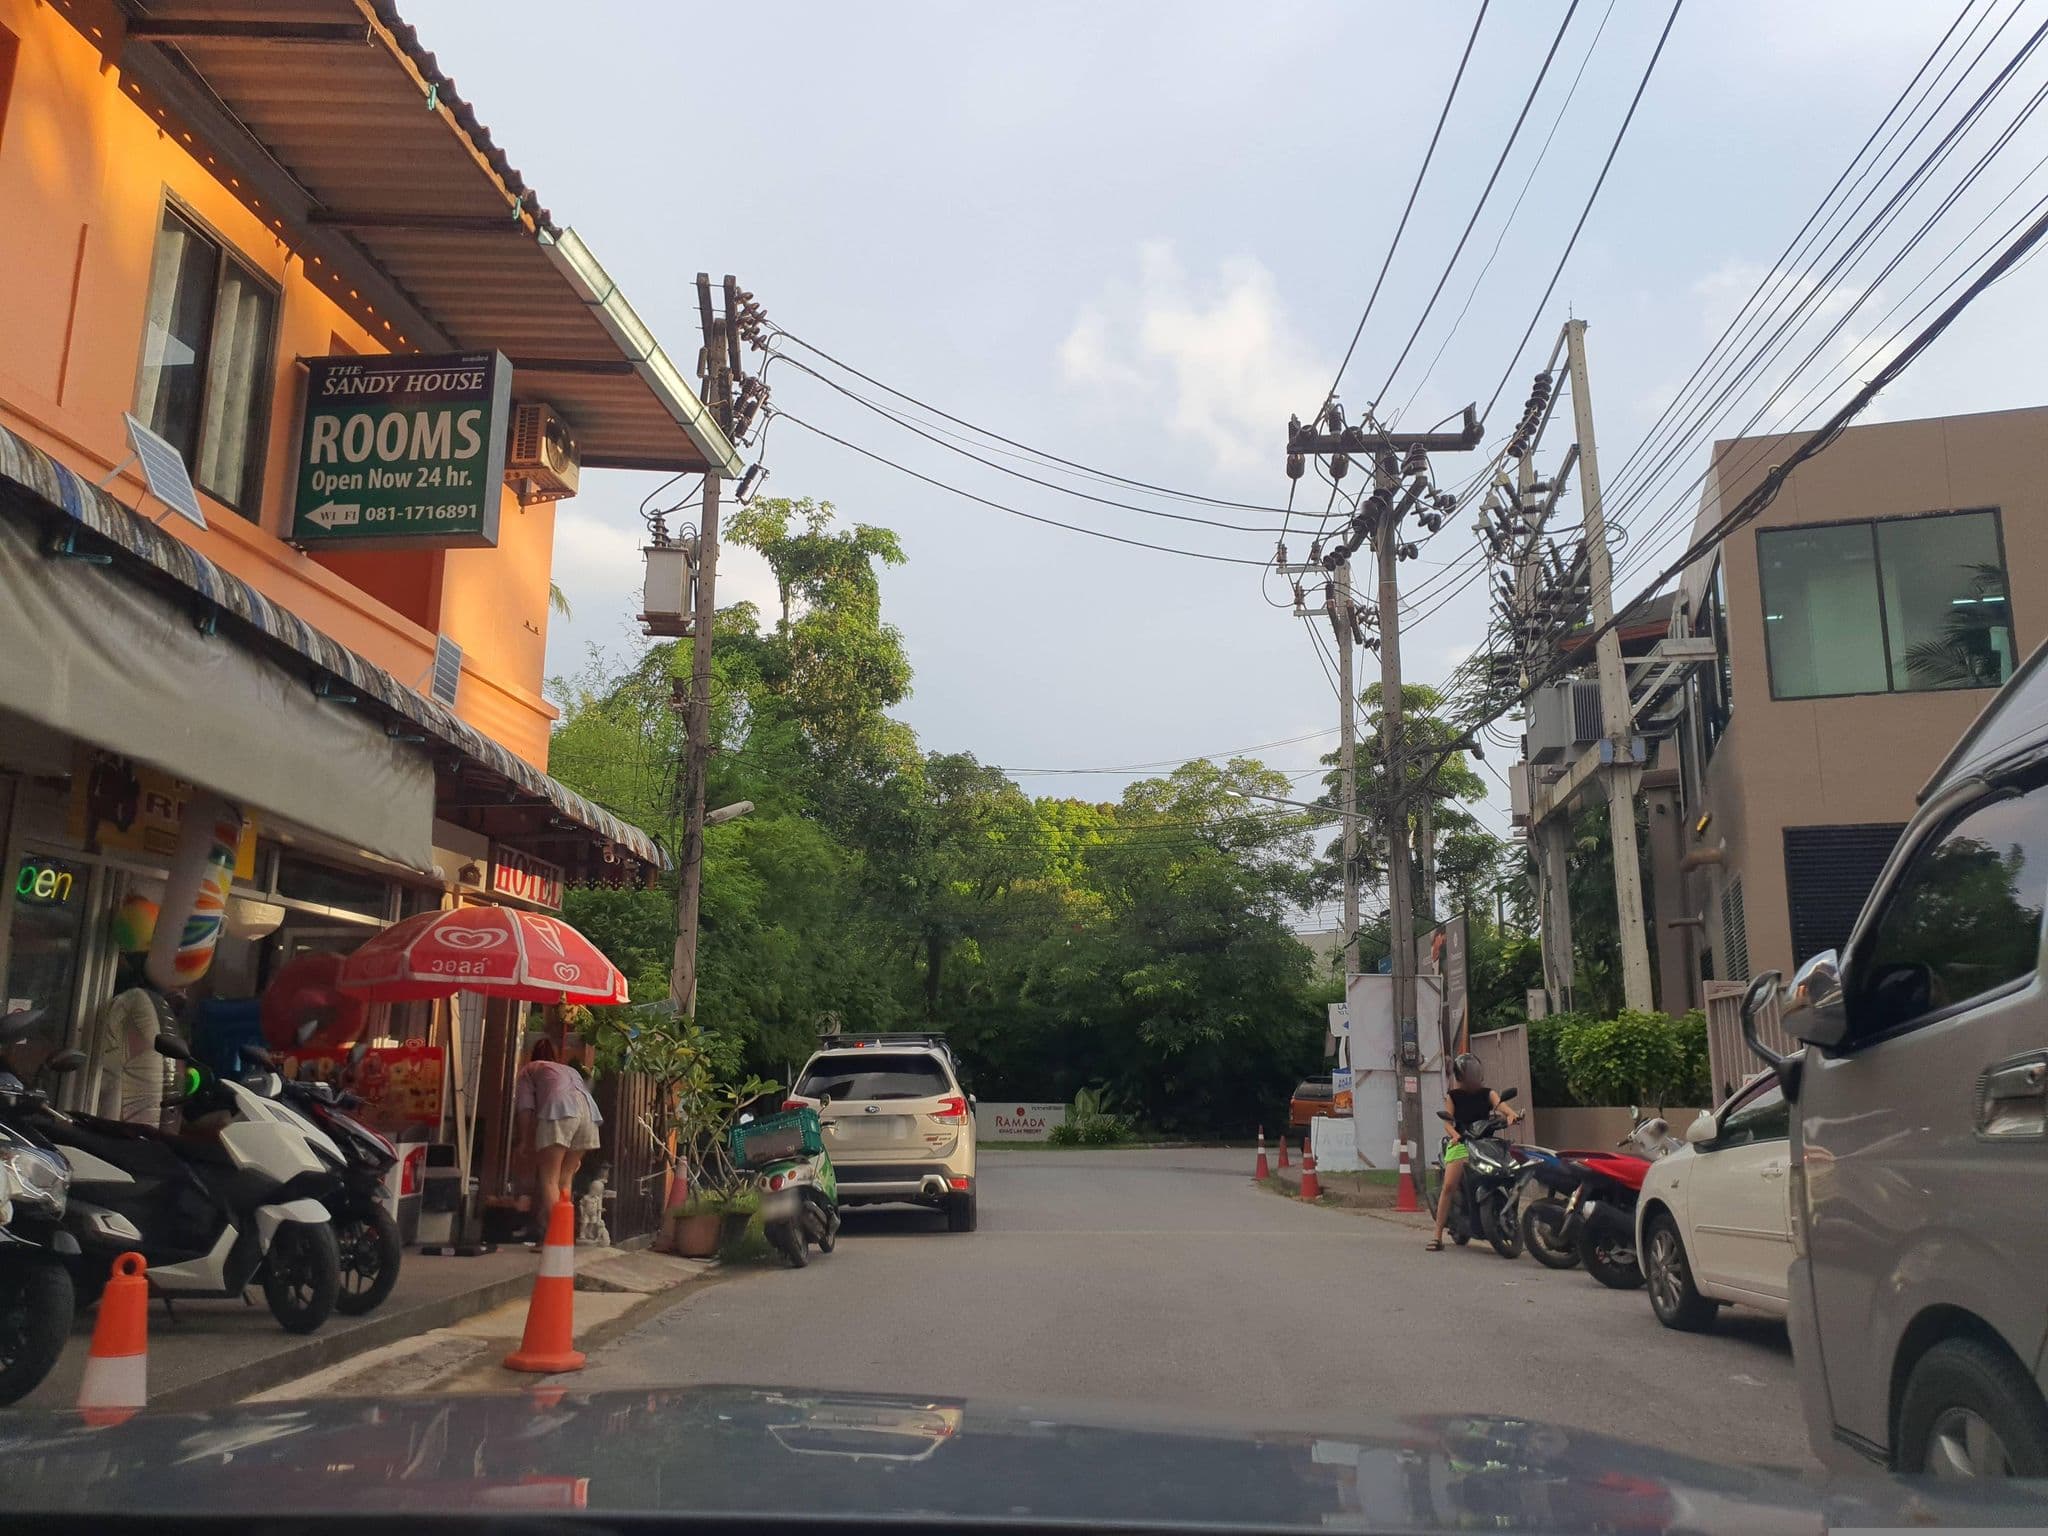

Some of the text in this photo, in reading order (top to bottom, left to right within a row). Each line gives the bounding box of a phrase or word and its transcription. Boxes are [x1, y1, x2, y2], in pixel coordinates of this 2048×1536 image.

[328, 365, 363, 376] THE
[322, 372, 485, 396] SANDY HOUSE
[310, 409, 482, 464] ROOMS
[312, 465, 473, 496] Open Now 24 hr.
[365, 504, 478, 521] 081-1716891
[496, 848, 561, 909] HOTEL
[995, 1115, 1046, 1128] RAMADA
